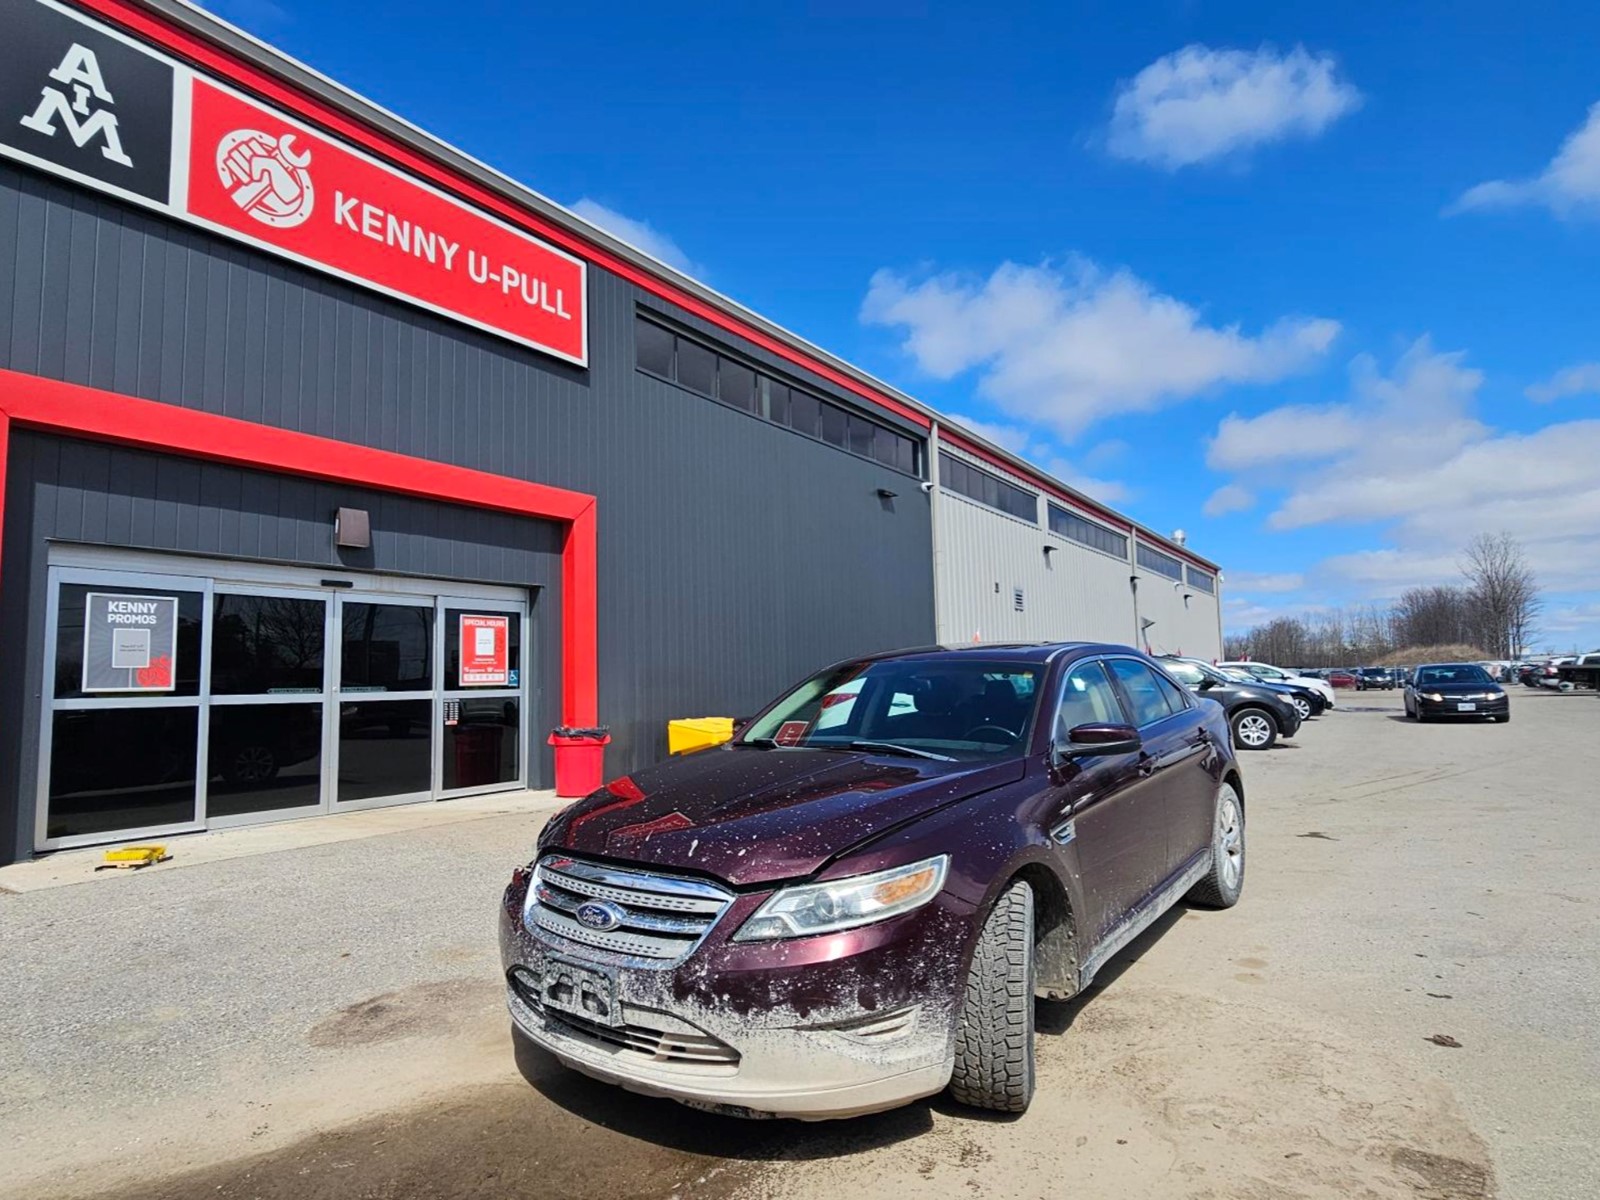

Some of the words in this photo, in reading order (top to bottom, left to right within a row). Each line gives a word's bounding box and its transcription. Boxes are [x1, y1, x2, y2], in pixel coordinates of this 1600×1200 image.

[335, 191, 460, 271] KENNY
[468, 250, 571, 320] U-PULL
[108, 601, 157, 613] KENNY
[107, 614, 157, 624] PROMOS
[583, 905, 605, 924] Ford
